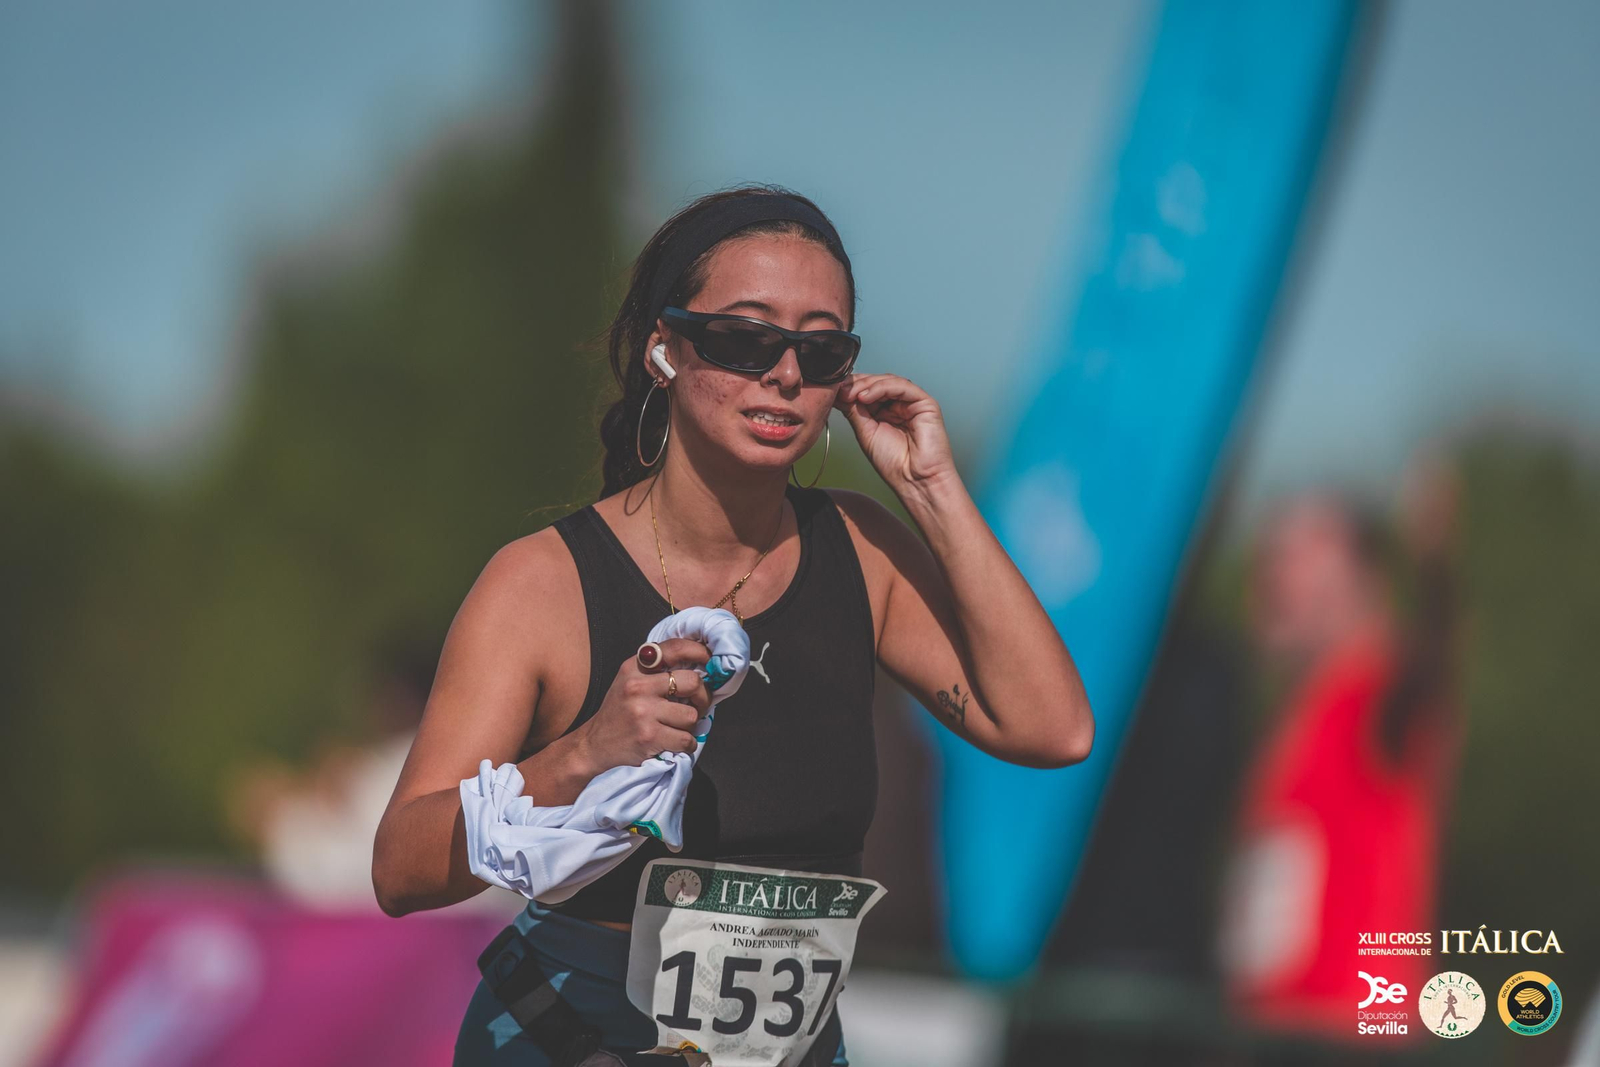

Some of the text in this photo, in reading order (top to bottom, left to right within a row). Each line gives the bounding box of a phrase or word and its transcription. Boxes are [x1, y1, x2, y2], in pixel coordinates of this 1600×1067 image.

[719, 877, 818, 910] ITÁLICA
[719, 904, 778, 917] INTERNATIONAL
[710, 922, 819, 938] ANDREA AGUADO MARÍN
[732, 938, 799, 949] INDEPENDIENTE
[656, 950, 842, 1037] 1537
